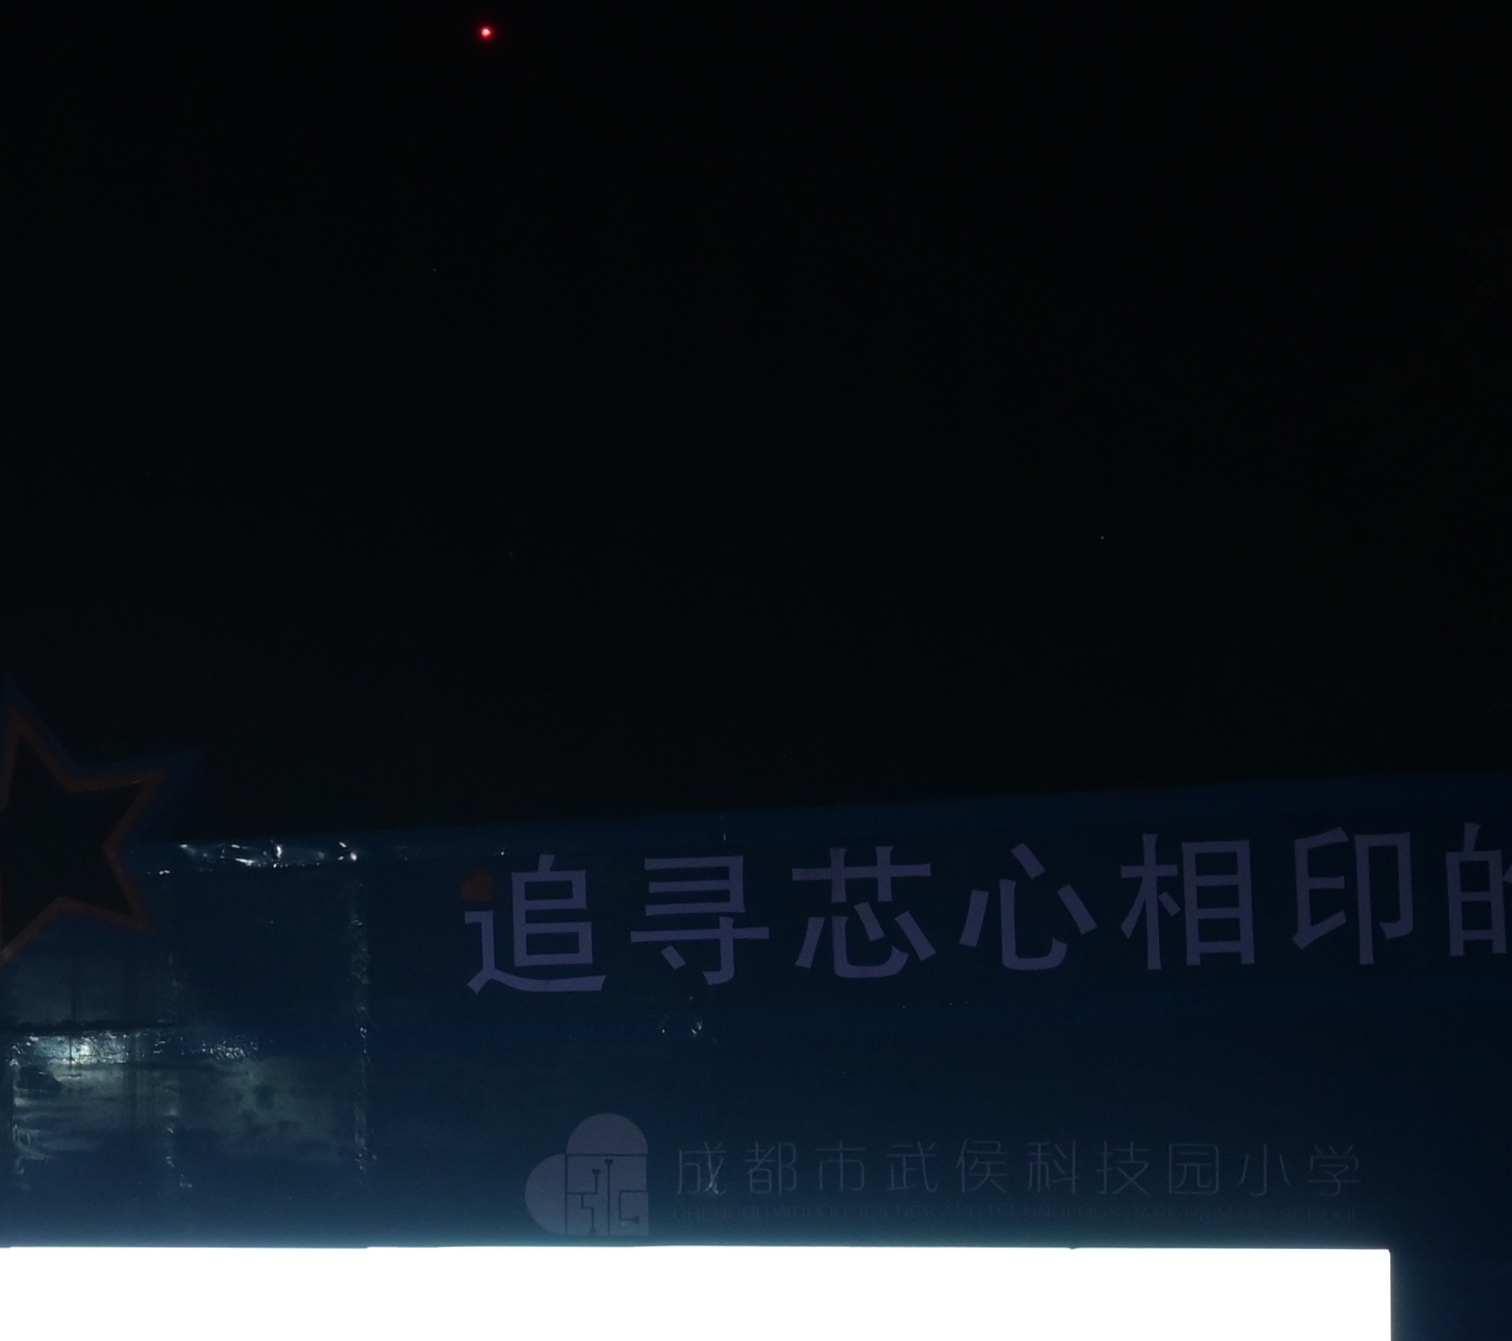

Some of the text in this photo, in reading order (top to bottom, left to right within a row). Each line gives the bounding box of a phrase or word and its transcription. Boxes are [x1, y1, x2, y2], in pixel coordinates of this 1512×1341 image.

[675, 1139, 1362, 1197] 成都市武侯科技园小学
